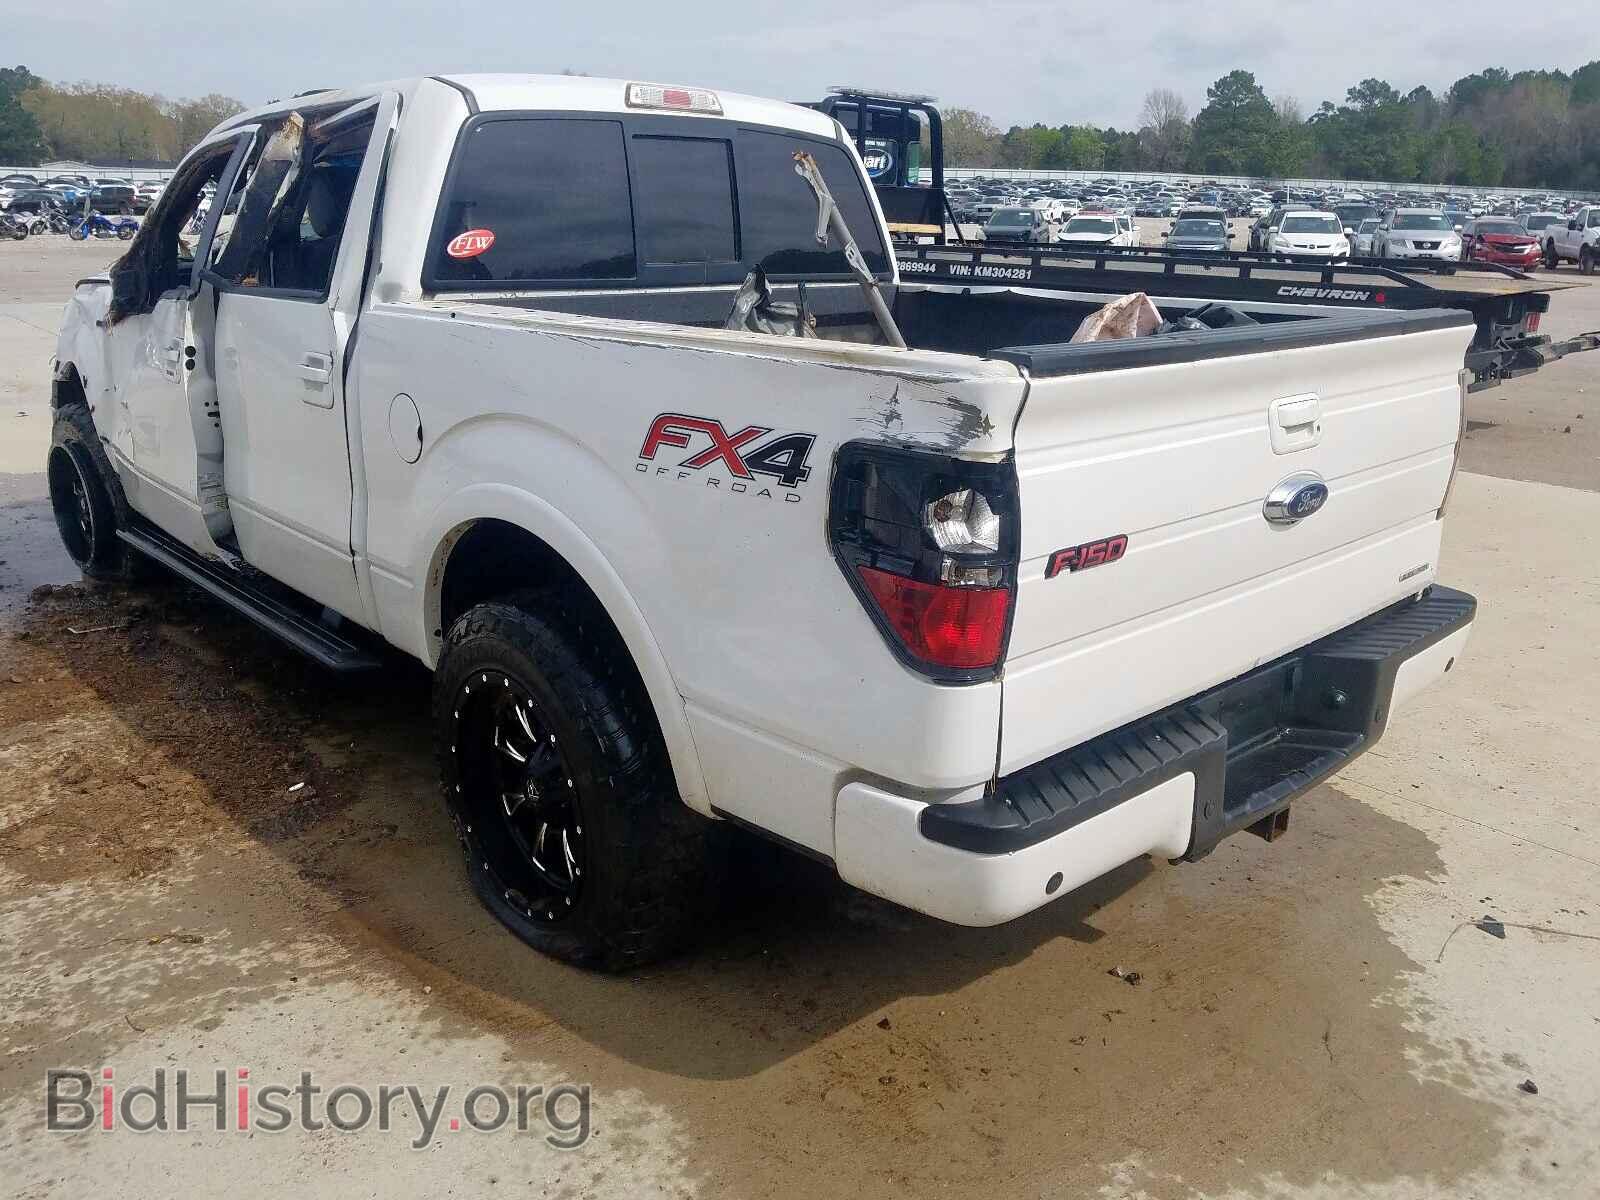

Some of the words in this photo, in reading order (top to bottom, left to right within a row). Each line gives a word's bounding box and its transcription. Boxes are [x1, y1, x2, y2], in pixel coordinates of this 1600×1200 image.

[949, 264, 971, 276] VIN:
[973, 266, 1032, 280] KM304281
[1277, 286, 1370, 301] CHEVRON
[639, 412, 817, 488] FX4
[706, 477, 801, 503] ROAD
[1045, 534, 1128, 579] F-150
